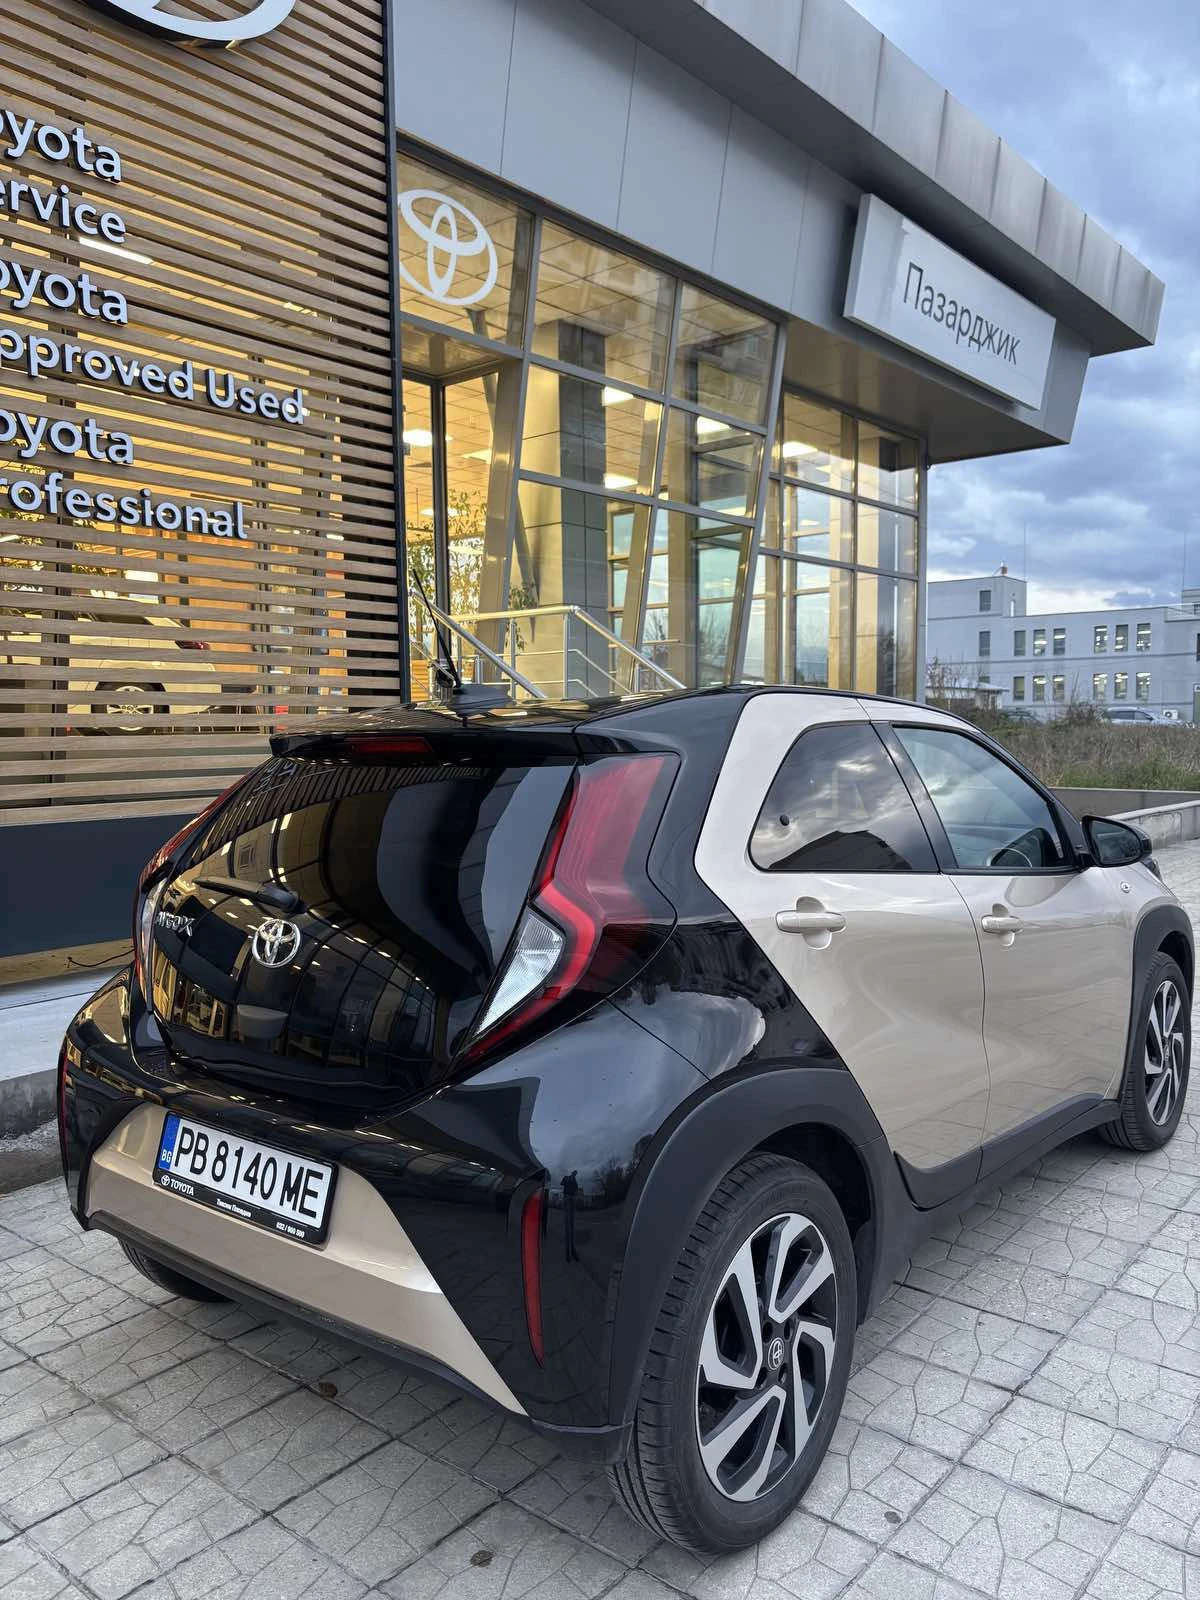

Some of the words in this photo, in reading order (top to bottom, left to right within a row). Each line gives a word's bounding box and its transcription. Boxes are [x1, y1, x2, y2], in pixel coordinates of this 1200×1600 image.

[0, 110, 122, 183] yota
[0, 179, 126, 244] rvice
[903, 261, 1021, 366] Пазарджик
[205, 367, 304, 425] Used
[161, 1149, 172, 1163] BG
[170, 1178, 194, 1196] TOYOTA
[174, 1126, 210, 1175] PB
[211, 1140, 278, 1201] 8140
[279, 1162, 324, 1219] ME
